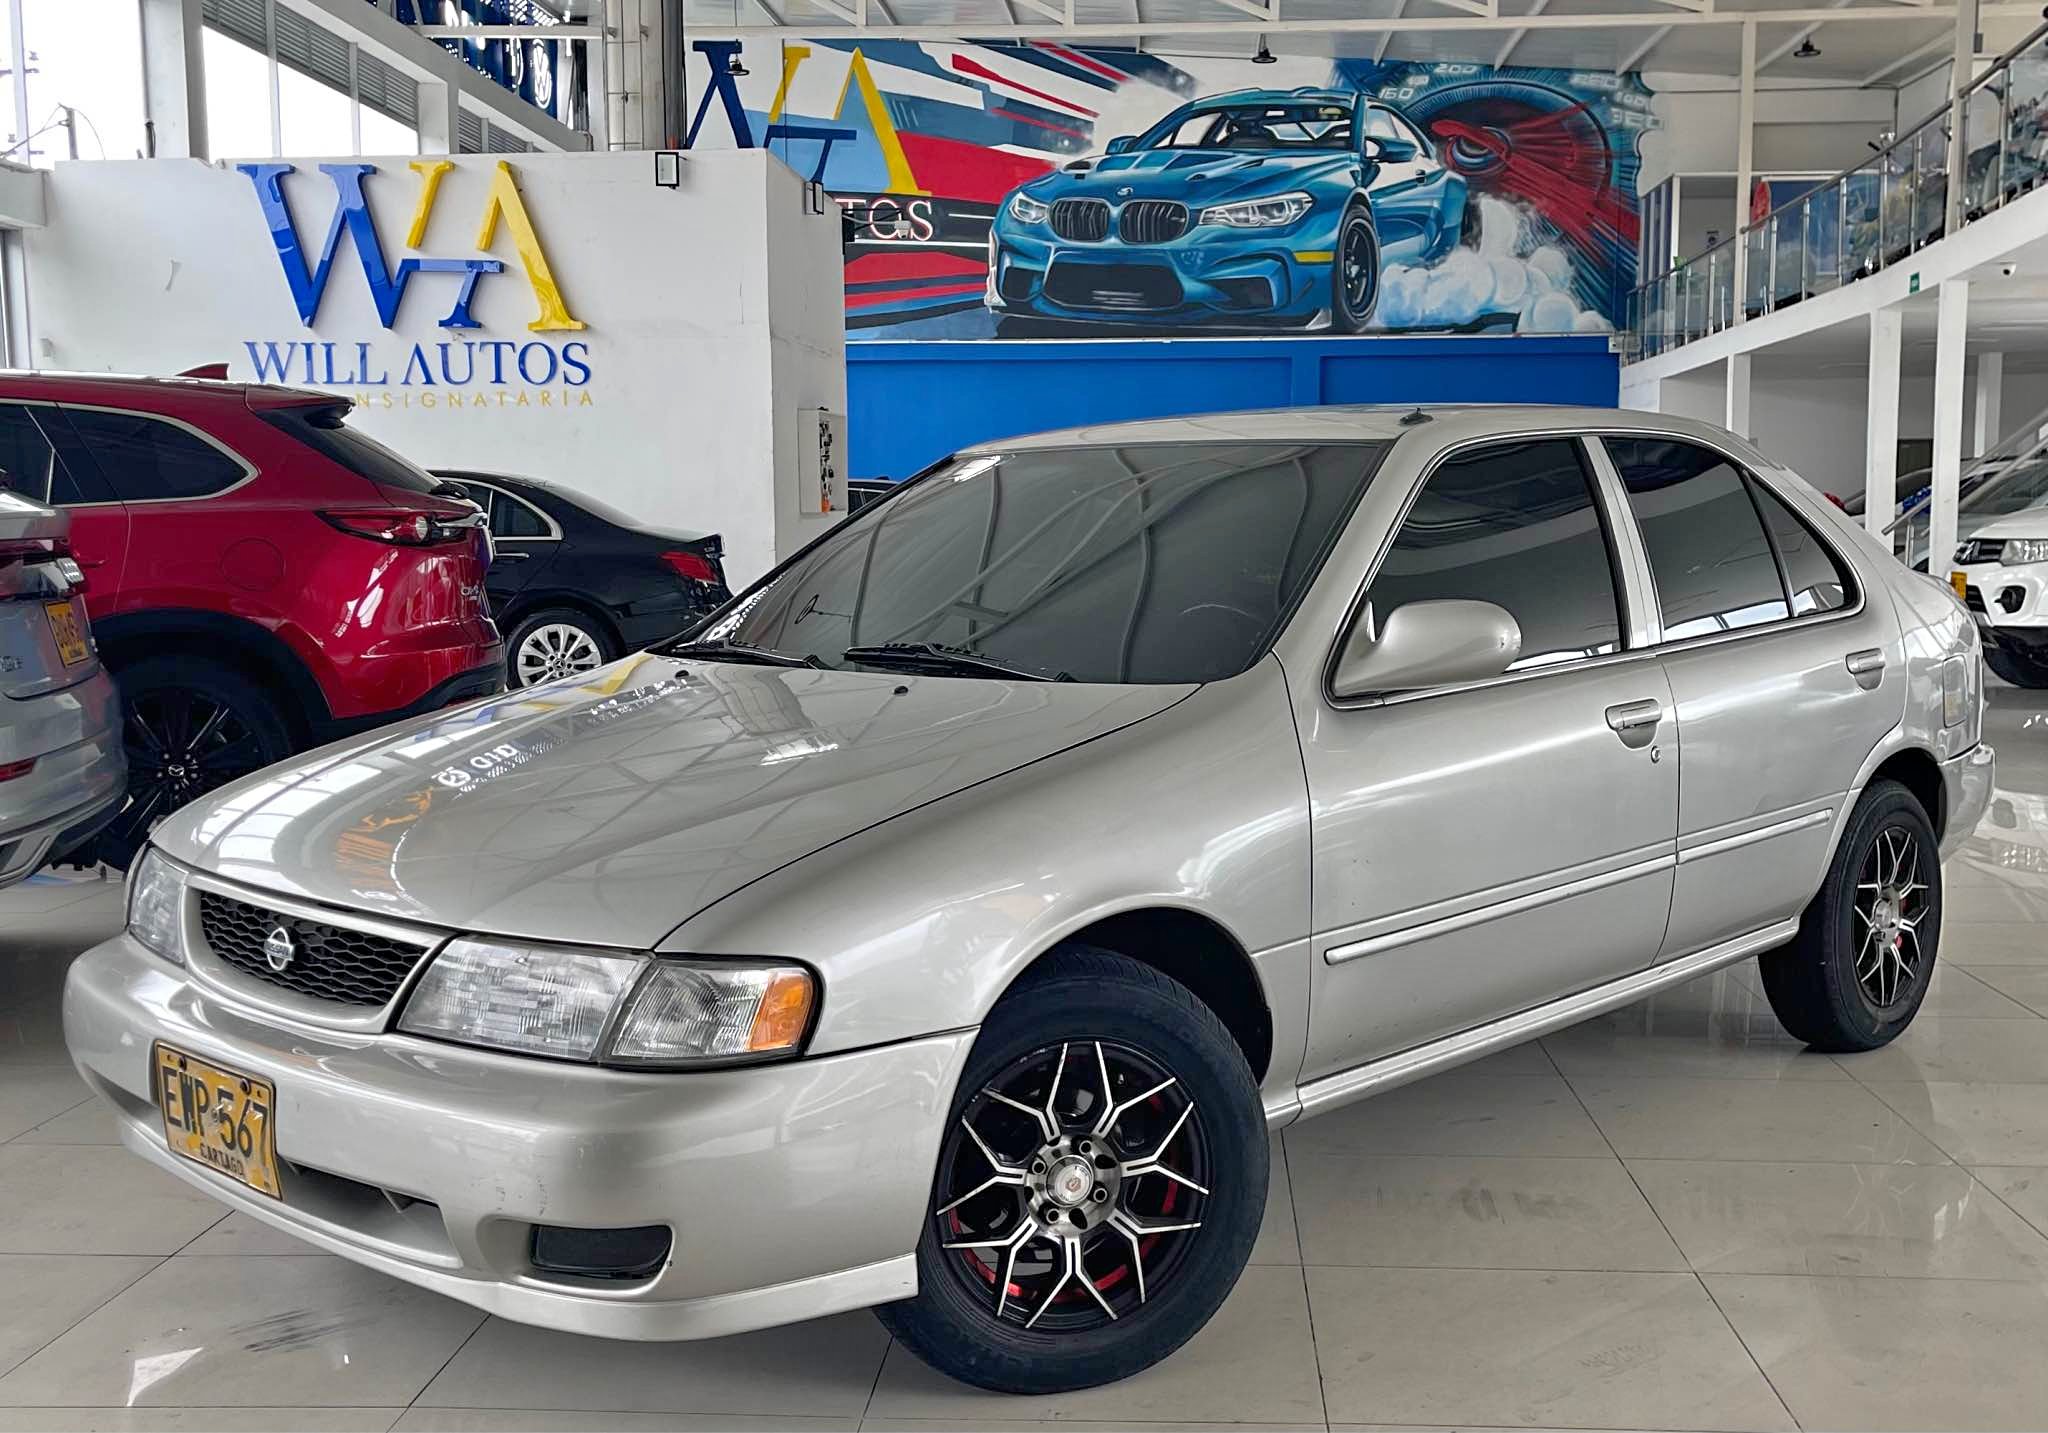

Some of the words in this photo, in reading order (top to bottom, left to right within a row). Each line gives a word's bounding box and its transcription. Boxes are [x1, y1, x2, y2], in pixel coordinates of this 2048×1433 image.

[1379, 87, 1414, 100] 160
[243, 341, 388, 386] WILL
[400, 341, 593, 386] AUTOS
[216, 1086, 268, 1168] 567
[199, 1142, 246, 1176] CARTAGO
